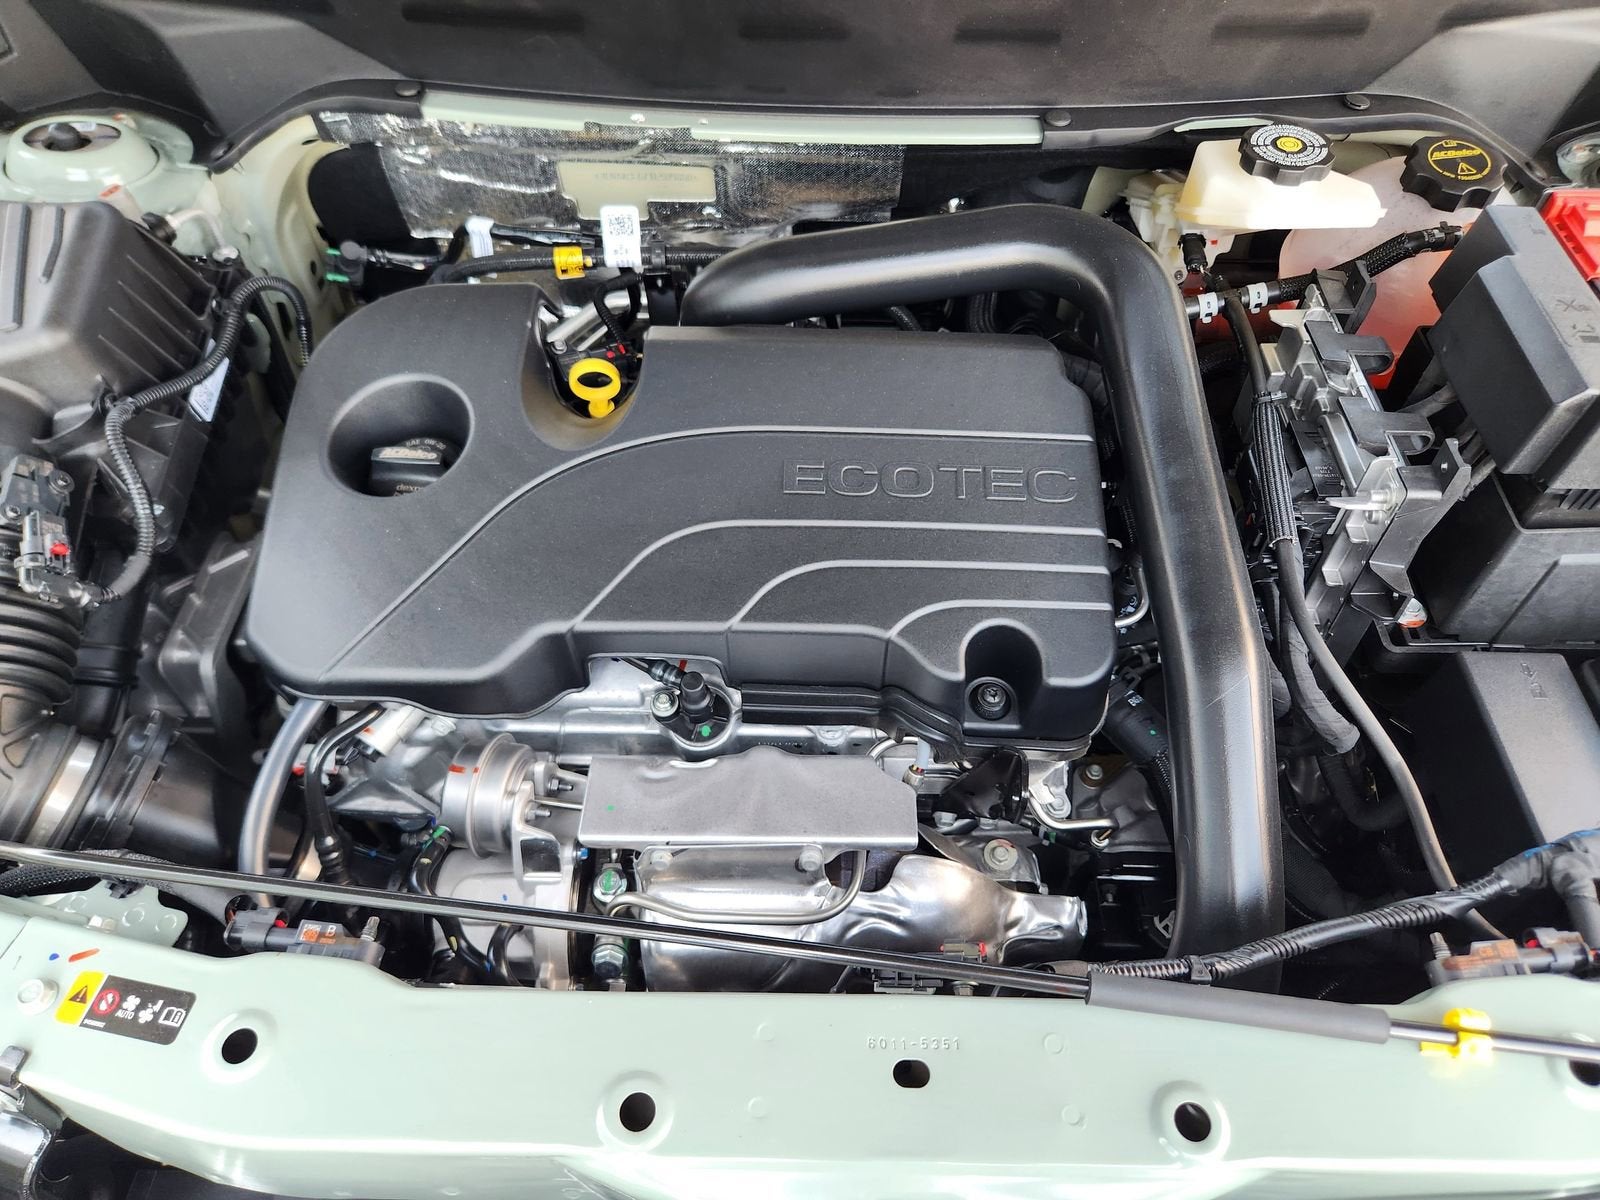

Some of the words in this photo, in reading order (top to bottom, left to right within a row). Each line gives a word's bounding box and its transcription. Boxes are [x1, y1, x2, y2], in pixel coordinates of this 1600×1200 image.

[1431, 149, 1481, 161] ACDelco
[378, 447, 438, 460] ACDelco
[783, 459, 1078, 504] ECOTEC
[325, 925, 337, 937] B
[115, 1009, 135, 1020] AUTO
